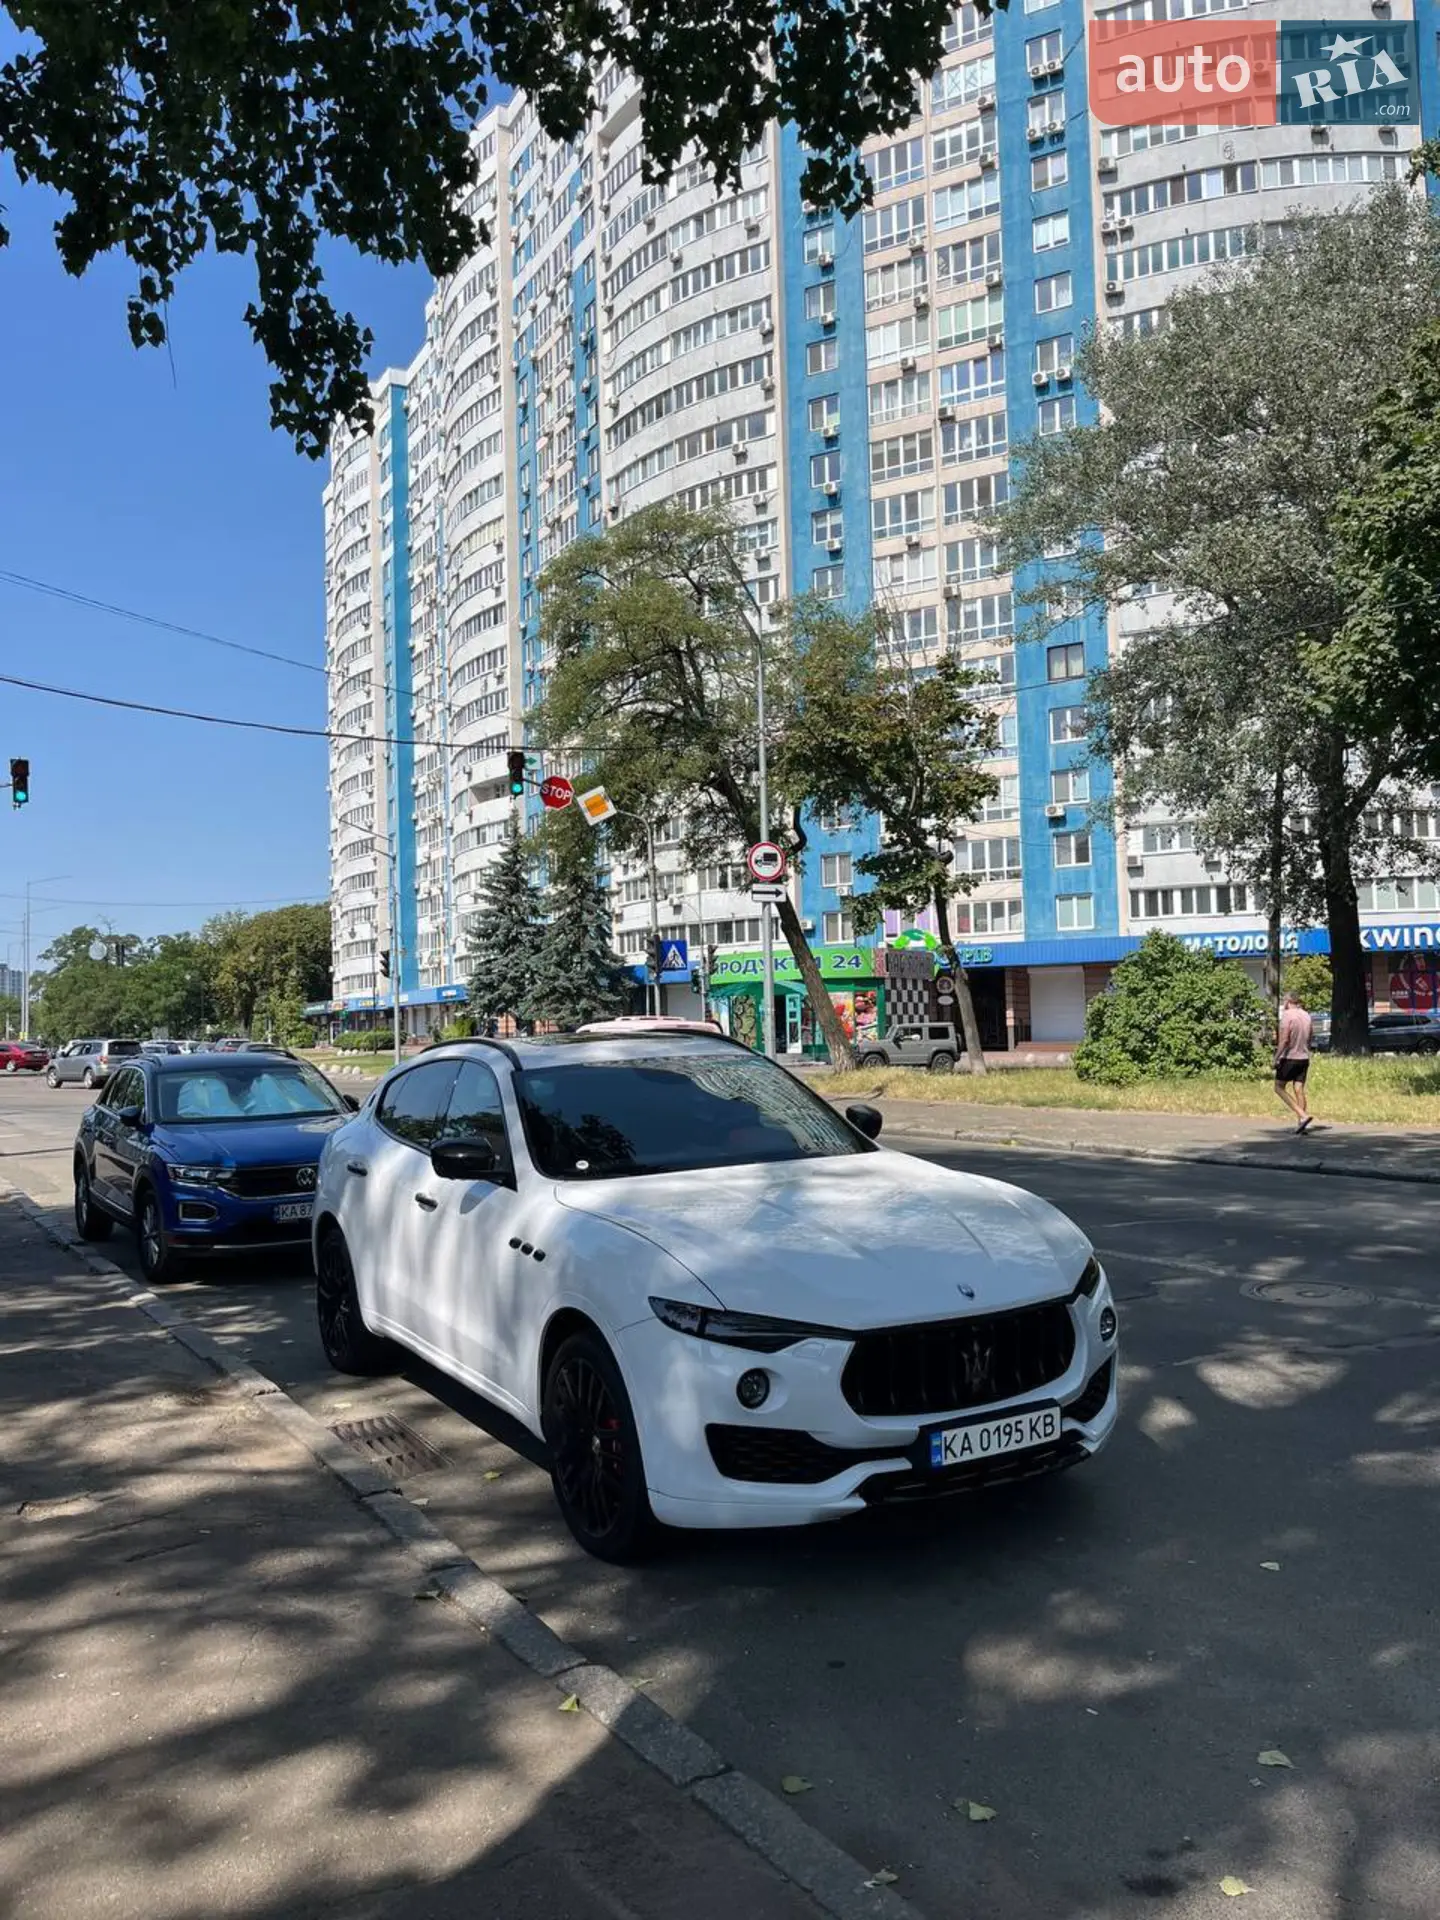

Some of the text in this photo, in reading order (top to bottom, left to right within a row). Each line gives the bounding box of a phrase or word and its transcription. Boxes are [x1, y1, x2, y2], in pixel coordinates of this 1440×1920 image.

[541, 783, 571, 800] STOP
[714, 955, 862, 975] РОДКТ 24
[944, 1414, 1056, 1461] KA 0195 KB
